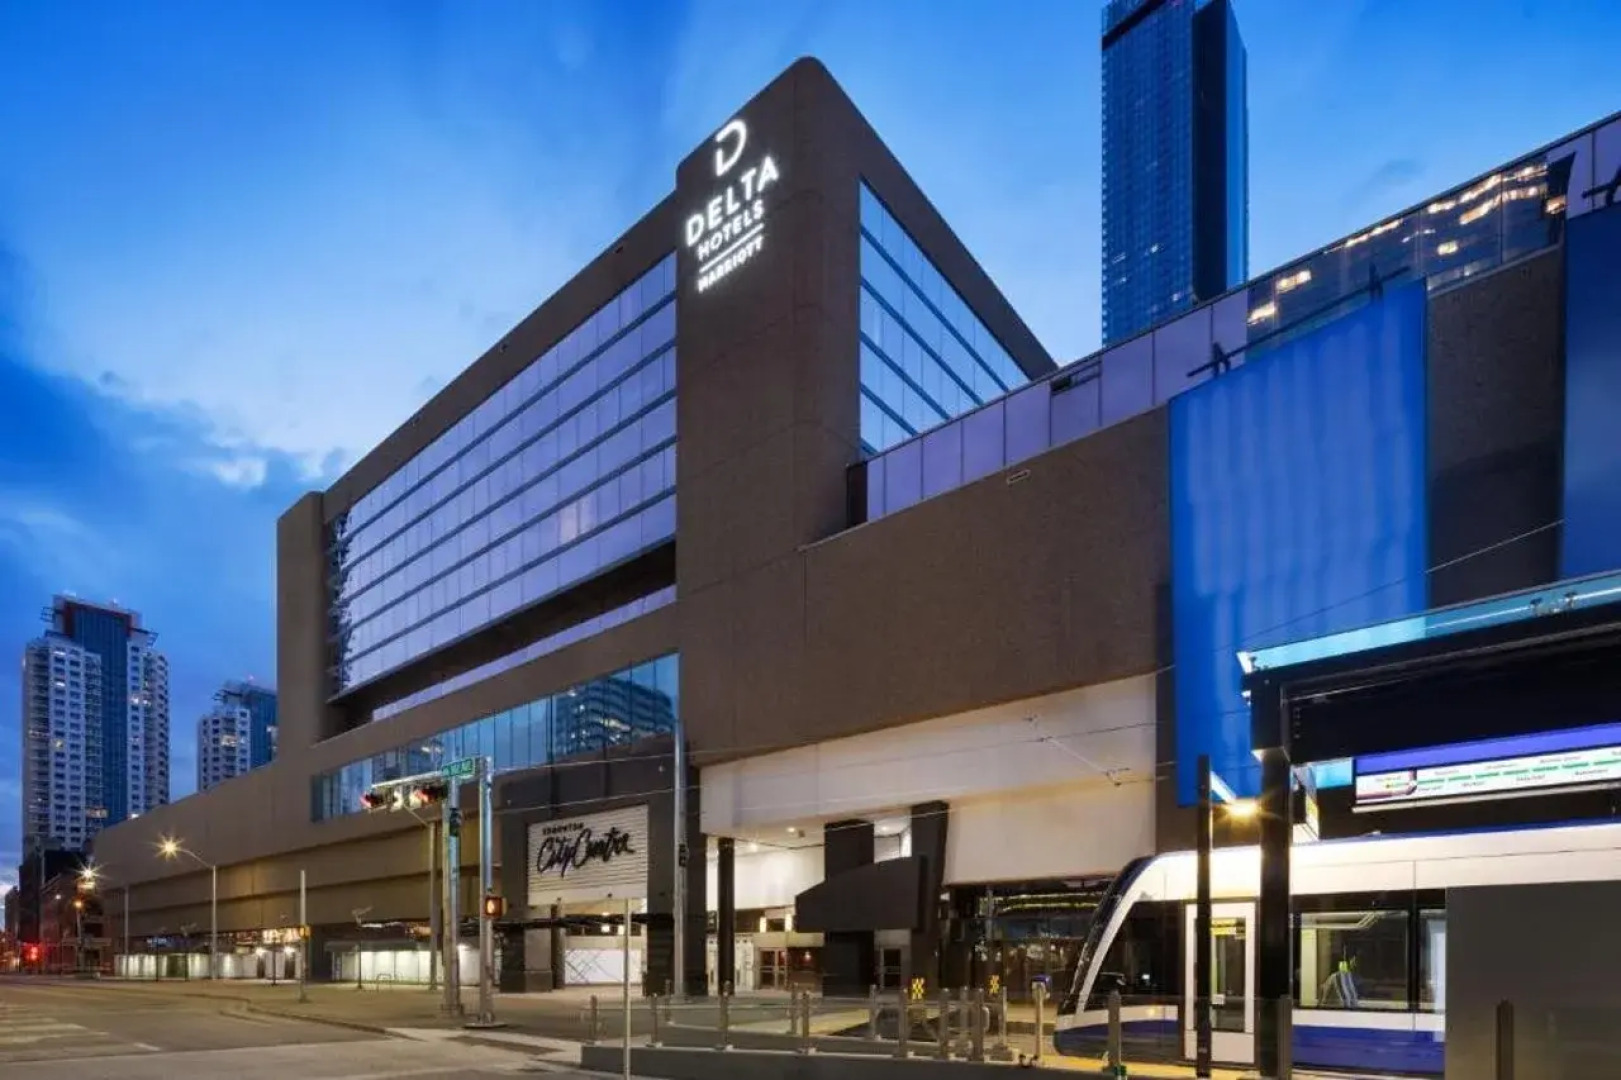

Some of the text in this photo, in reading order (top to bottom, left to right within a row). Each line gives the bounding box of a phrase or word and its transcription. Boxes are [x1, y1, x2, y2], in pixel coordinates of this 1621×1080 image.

[715, 119, 747, 177] D
[685, 155, 779, 247] DELTA
[697, 199, 764, 262] HOTELS
[697, 234, 764, 293] MARRIOTT
